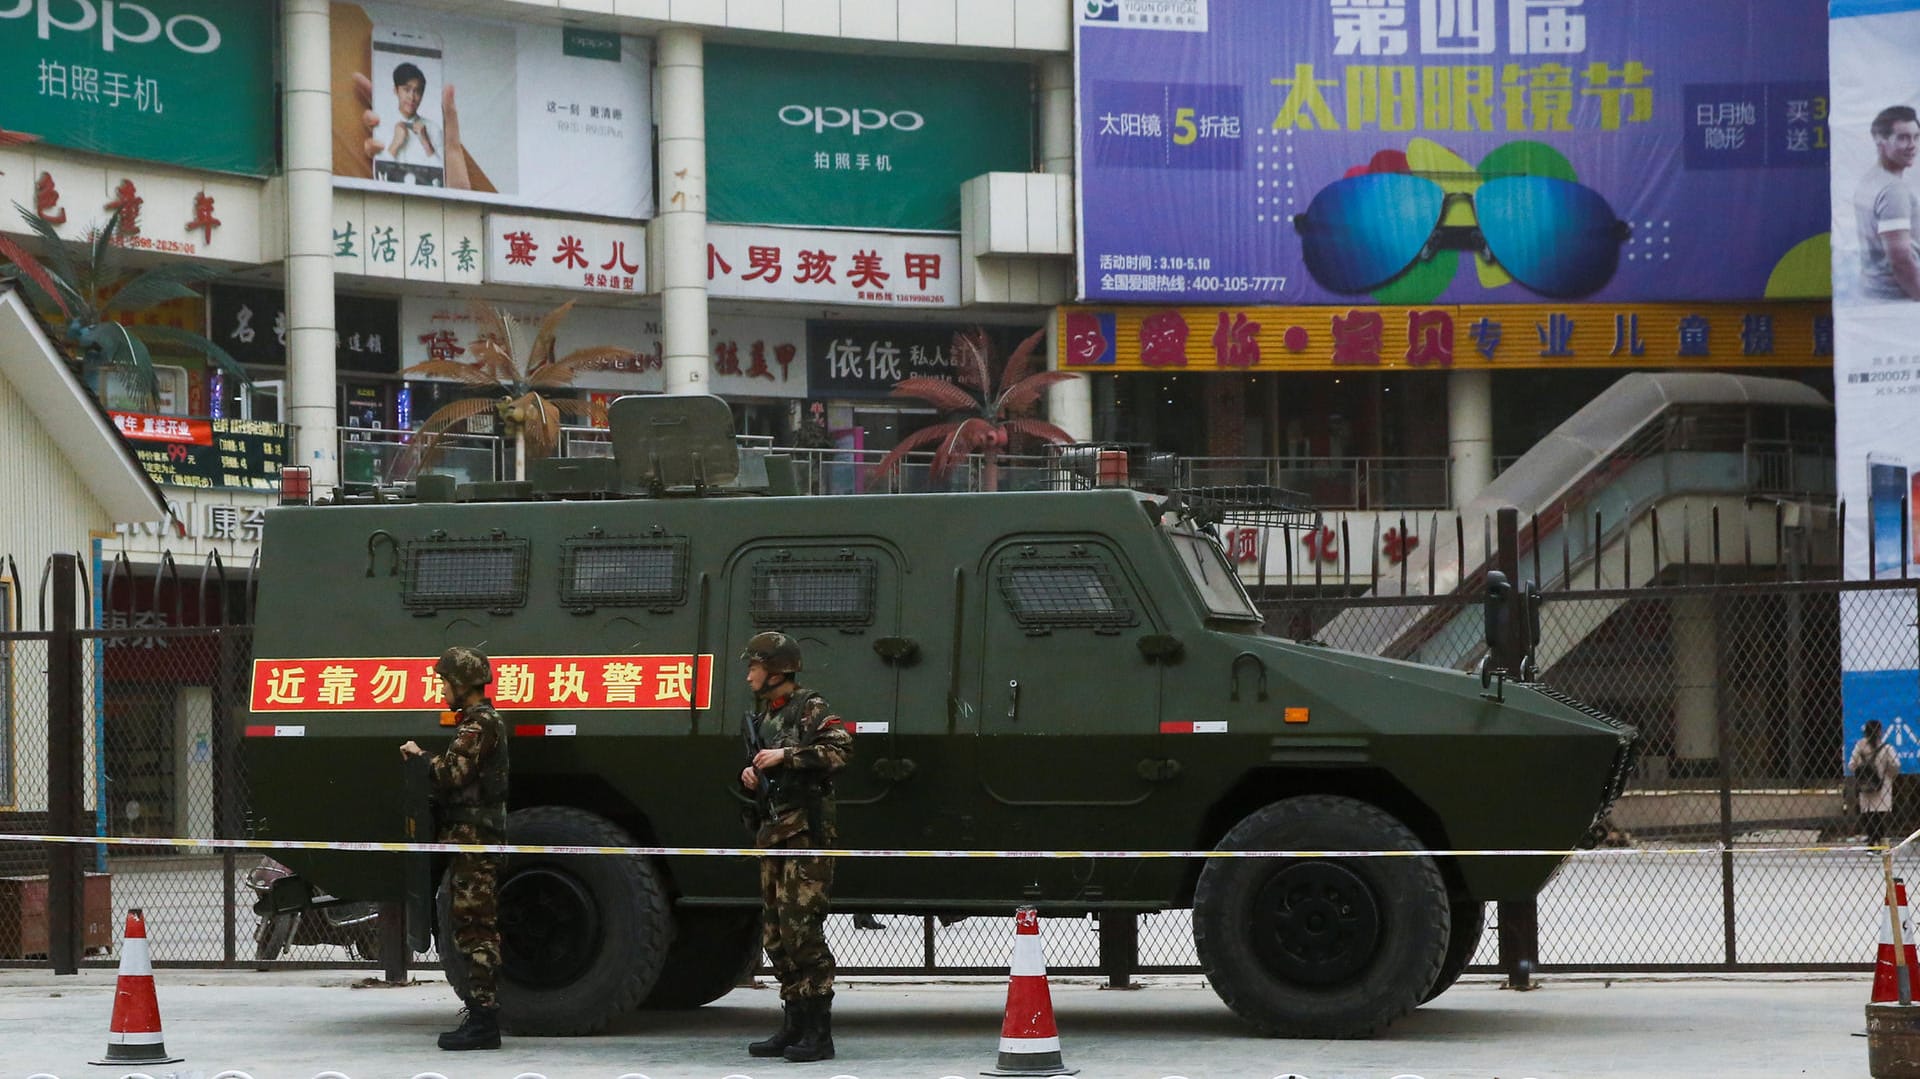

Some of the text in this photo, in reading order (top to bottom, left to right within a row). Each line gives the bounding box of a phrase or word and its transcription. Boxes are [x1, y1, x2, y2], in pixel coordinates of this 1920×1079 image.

[1333, 0, 1587, 55] 第四届
[38, 59, 163, 114] 拍照手机
[1271, 62, 1654, 131] 太阳眼镜节
[1100, 108, 1241, 145] 太阳镜 5折起
[1696, 102, 1756, 126] 日月抛
[814, 152, 892, 172] 拍照手机
[332, 221, 478, 272] 生活原素
[503, 231, 639, 275] 黛米儿
[826, 339, 903, 380] 依依
